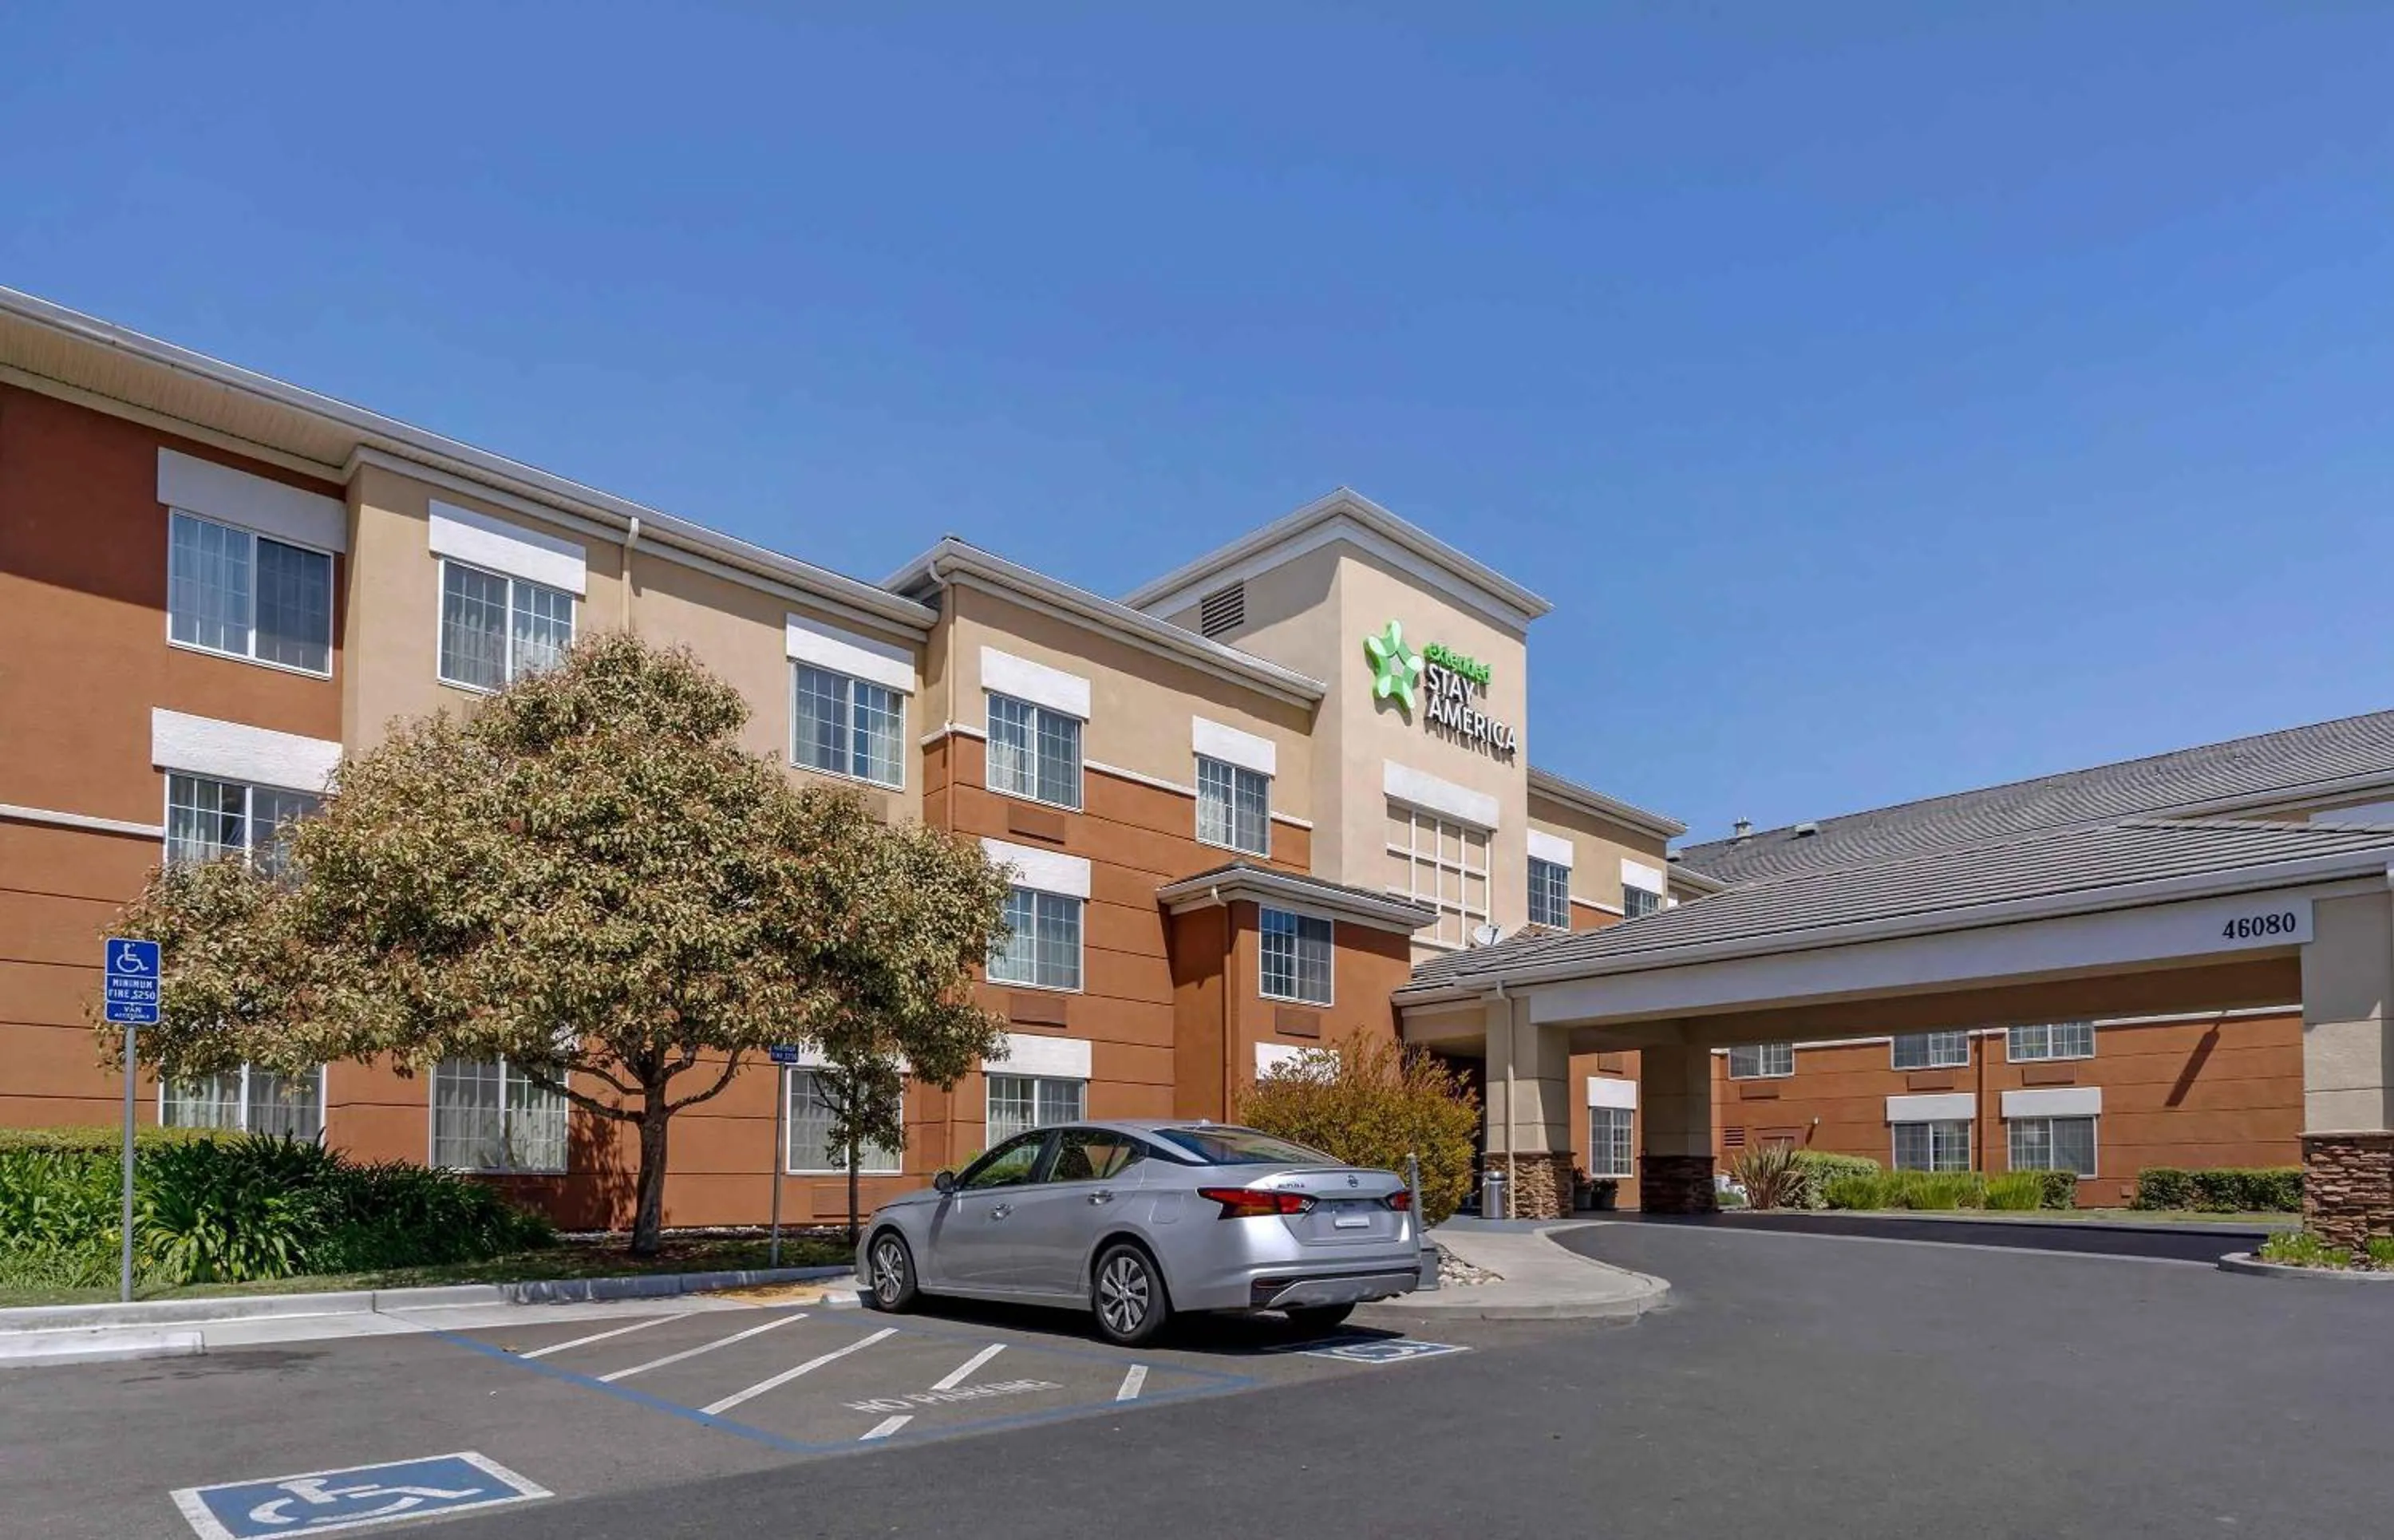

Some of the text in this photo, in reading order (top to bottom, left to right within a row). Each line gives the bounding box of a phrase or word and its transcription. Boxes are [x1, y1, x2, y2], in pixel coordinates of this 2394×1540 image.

[1428, 663, 1476, 705] STAY
[1428, 693, 1518, 752] AMERICA
[2222, 912, 2297, 939] 46080
[113, 977, 152, 989] MINIMUM
